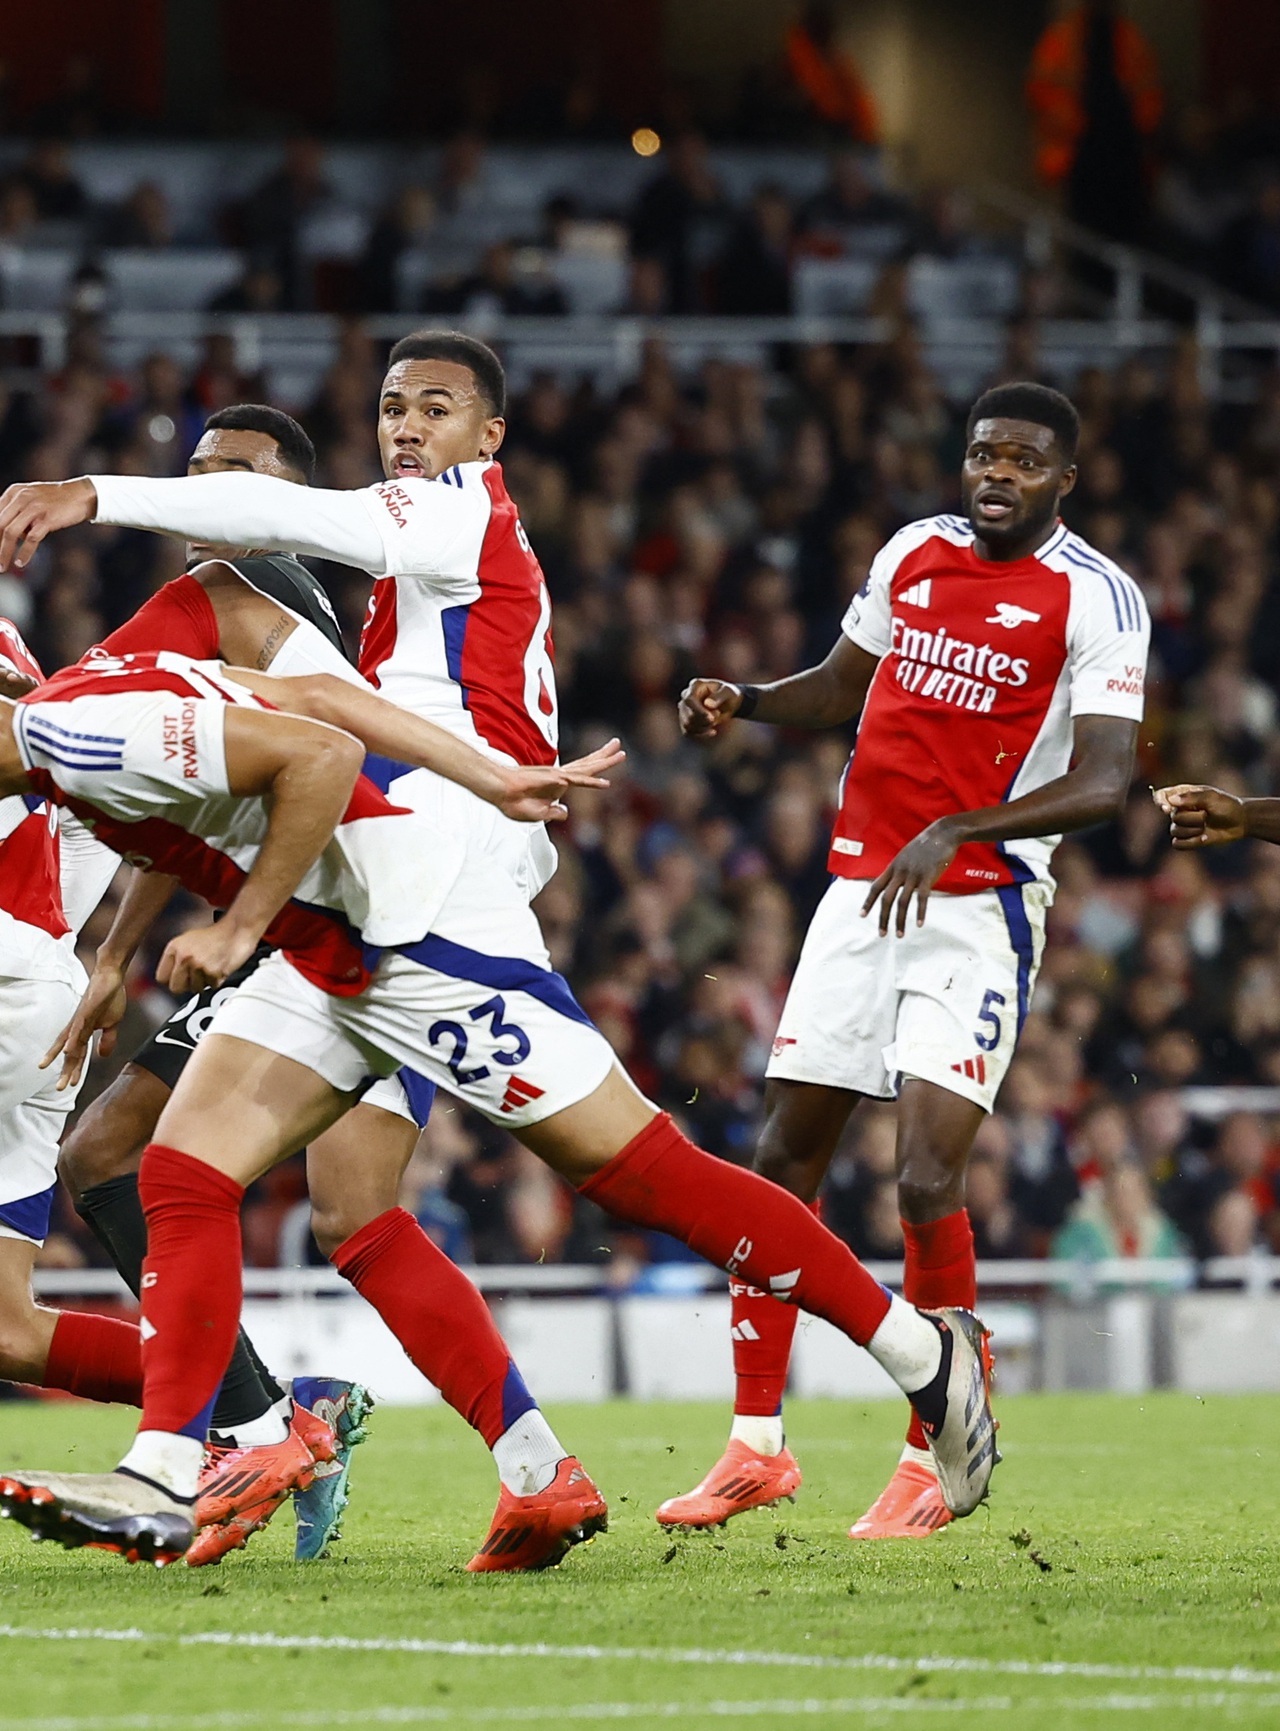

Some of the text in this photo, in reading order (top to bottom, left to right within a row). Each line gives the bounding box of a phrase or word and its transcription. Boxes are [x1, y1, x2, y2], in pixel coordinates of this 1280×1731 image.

[891, 616, 1031, 687] Emirates
[895, 659, 998, 713] FLY BETTER
[163, 714, 179, 762] VISIT
[427, 993, 531, 1087] 23
[973, 987, 1007, 1052] 5
